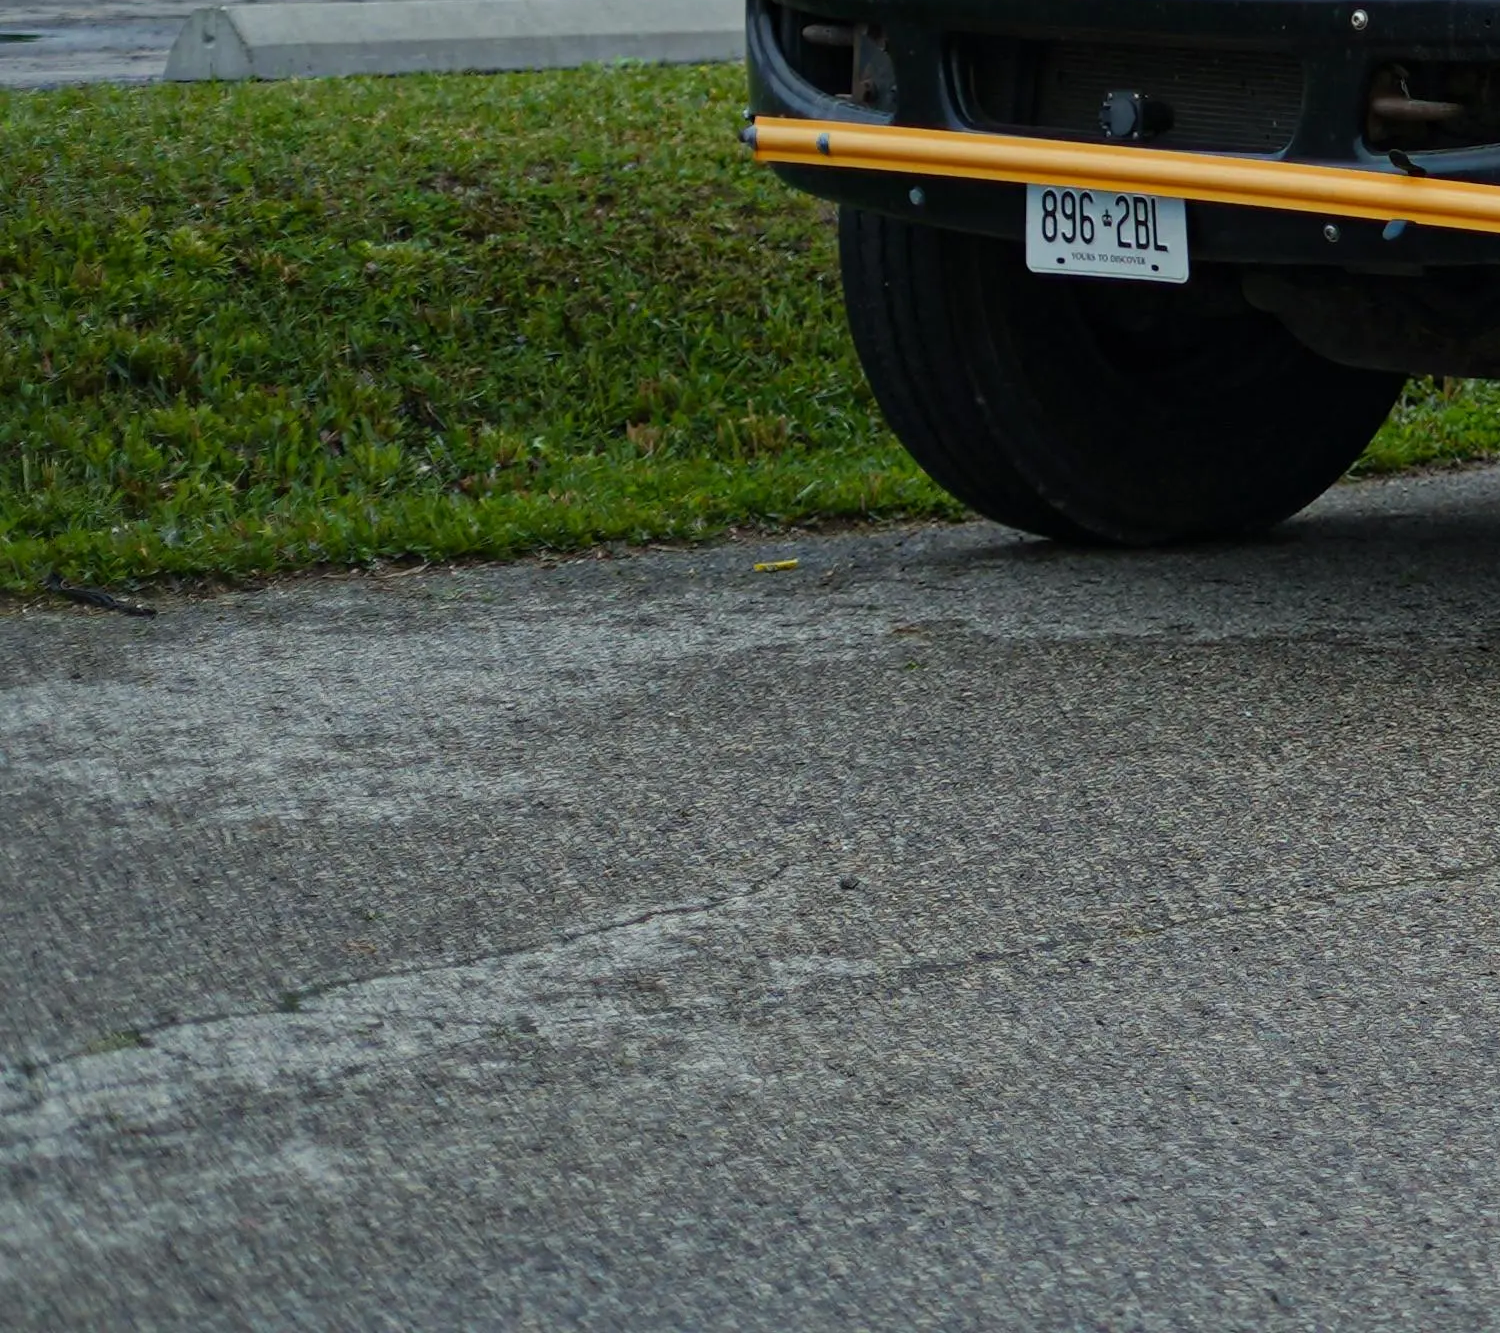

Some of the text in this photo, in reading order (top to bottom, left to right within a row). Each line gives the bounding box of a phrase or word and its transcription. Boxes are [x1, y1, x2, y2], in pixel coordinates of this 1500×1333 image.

[1041, 190, 1169, 253] 896 2BL
[1071, 252, 1146, 265] YOURS TO DISCOVER
